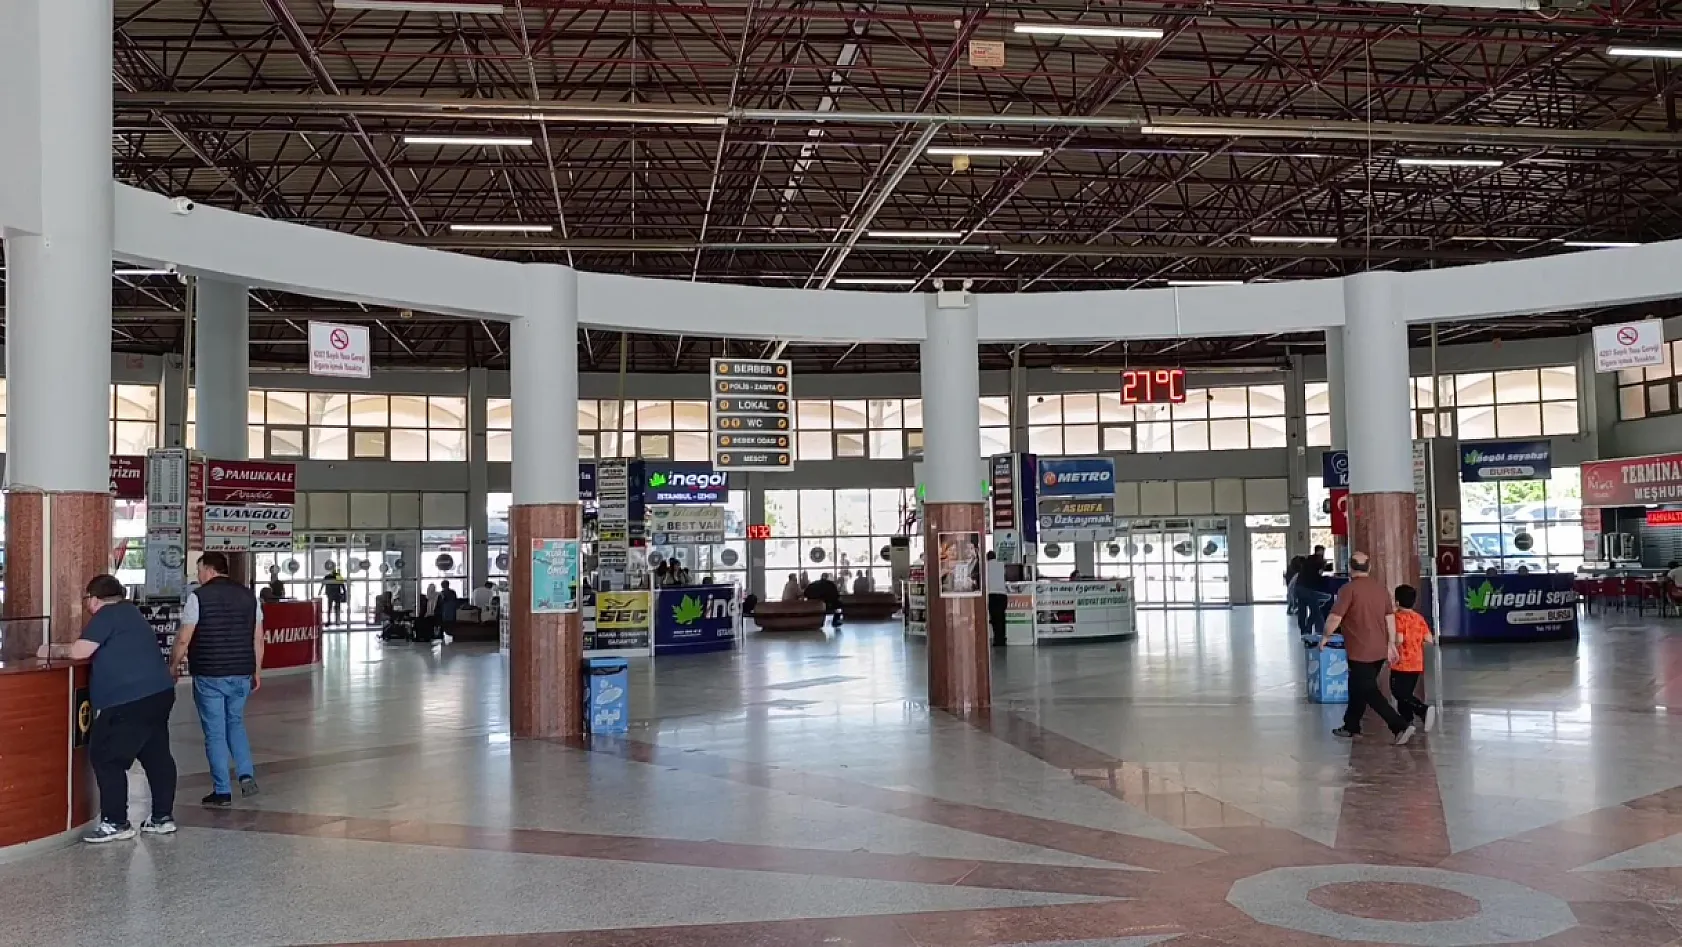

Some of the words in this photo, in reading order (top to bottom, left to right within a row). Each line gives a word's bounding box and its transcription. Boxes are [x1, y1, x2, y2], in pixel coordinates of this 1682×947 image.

[734, 364, 773, 374] BERBER
[1123, 370, 1183, 402] 27°C
[738, 401, 770, 410] LOKAL
[747, 419, 763, 428] WC
[225, 470, 294, 482] PAMUKKALE
[1058, 471, 1110, 483] METRO
[1489, 467, 1524, 476] BURSA
[1621, 459, 1682, 484] TERMİNA
[668, 471, 727, 489] inegöl
[223, 508, 290, 520] VANGÖLÜ
[667, 521, 696, 530] BEST
[1482, 589, 1542, 607] inegöl
